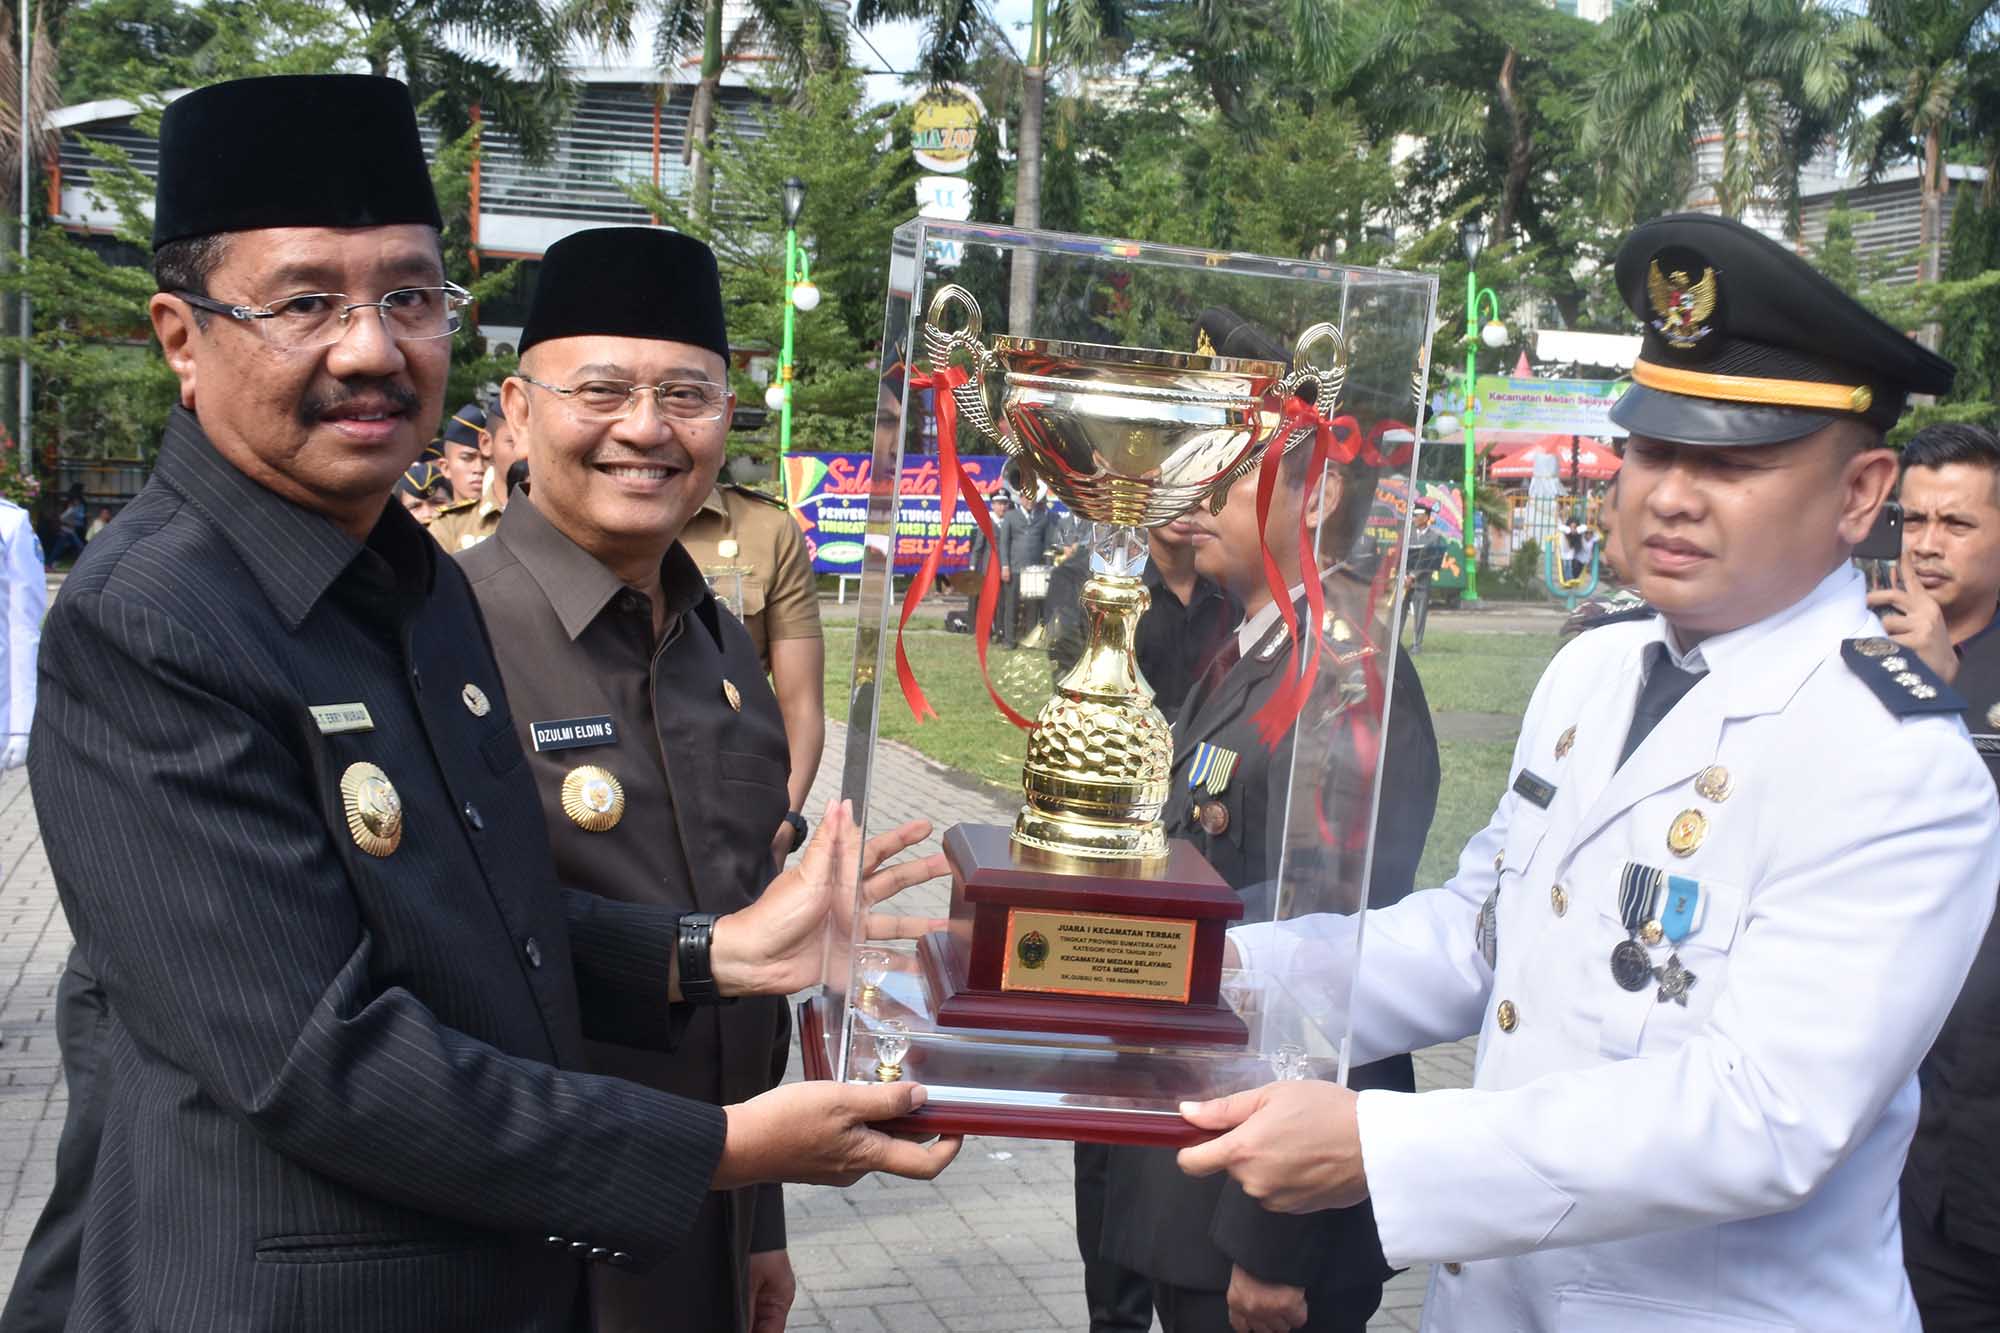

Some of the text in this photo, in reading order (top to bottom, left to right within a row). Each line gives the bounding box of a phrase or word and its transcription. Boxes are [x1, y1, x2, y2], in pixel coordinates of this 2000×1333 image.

[1577, 394, 1618, 407] Selayan
[537, 722, 613, 743] DZULMI ELDIN S
[1058, 924, 1085, 933] JUARA
[1093, 927, 1143, 938] KECAMATAN
[1145, 931, 1182, 940] TERBAIK
[1061, 935, 1087, 944] TINGKAT
[1088, 938, 1119, 946] PROVINSI
[1120, 940, 1154, 949] SUMATERA
[1073, 945, 1105, 953] KATEGORI
[1060, 955, 1173, 969] KECAMATAN MEDAN SELAYANG
